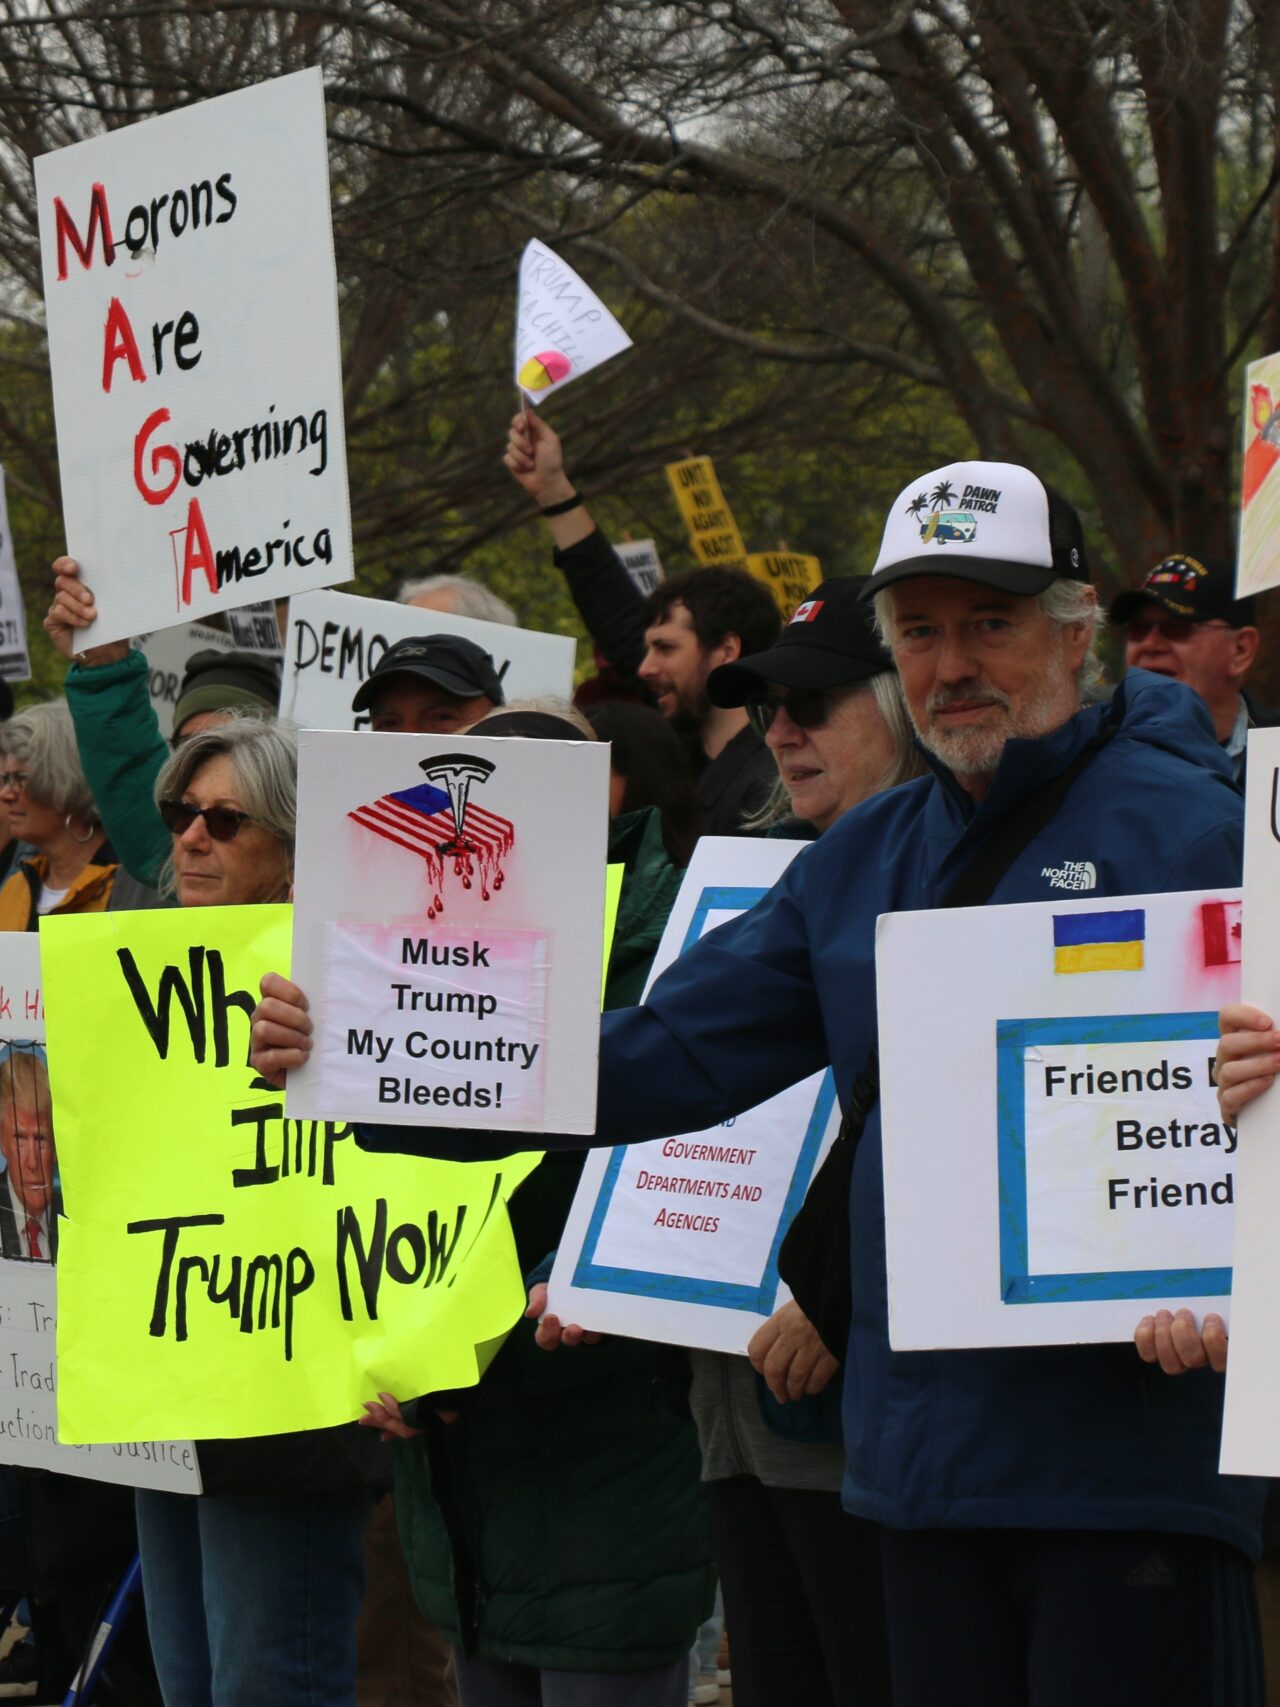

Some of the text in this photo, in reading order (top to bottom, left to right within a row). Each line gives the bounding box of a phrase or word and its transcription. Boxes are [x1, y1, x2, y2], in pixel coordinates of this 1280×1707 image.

[53, 171, 238, 282] Morons
[102, 296, 203, 394] Are
[133, 404, 328, 506] Governing
[958, 498, 999, 514] PATROL
[962, 484, 1002, 502] DAWN
[175, 496, 333, 608] America
[147, 665, 179, 703] OR
[1040, 867, 1083, 881] NORTH
[1049, 877, 1081, 890] FACE
[1063, 860, 1086, 872] THE
[401, 937, 491, 969] Musk
[115, 945, 258, 1069] Wh
[391, 983, 498, 1021] Trump
[346, 1028, 540, 1070] My Country
[378, 1076, 504, 1110] Bleeds!
[1044, 1059, 1194, 1097] Friends
[231, 1102, 355, 1189] Imp
[730, 1184, 763, 1203] AND
[126, 1213, 316, 1362] Trump
[27, 1301, 58, 1334] Tr
[10, 1352, 58, 1394] Trad
